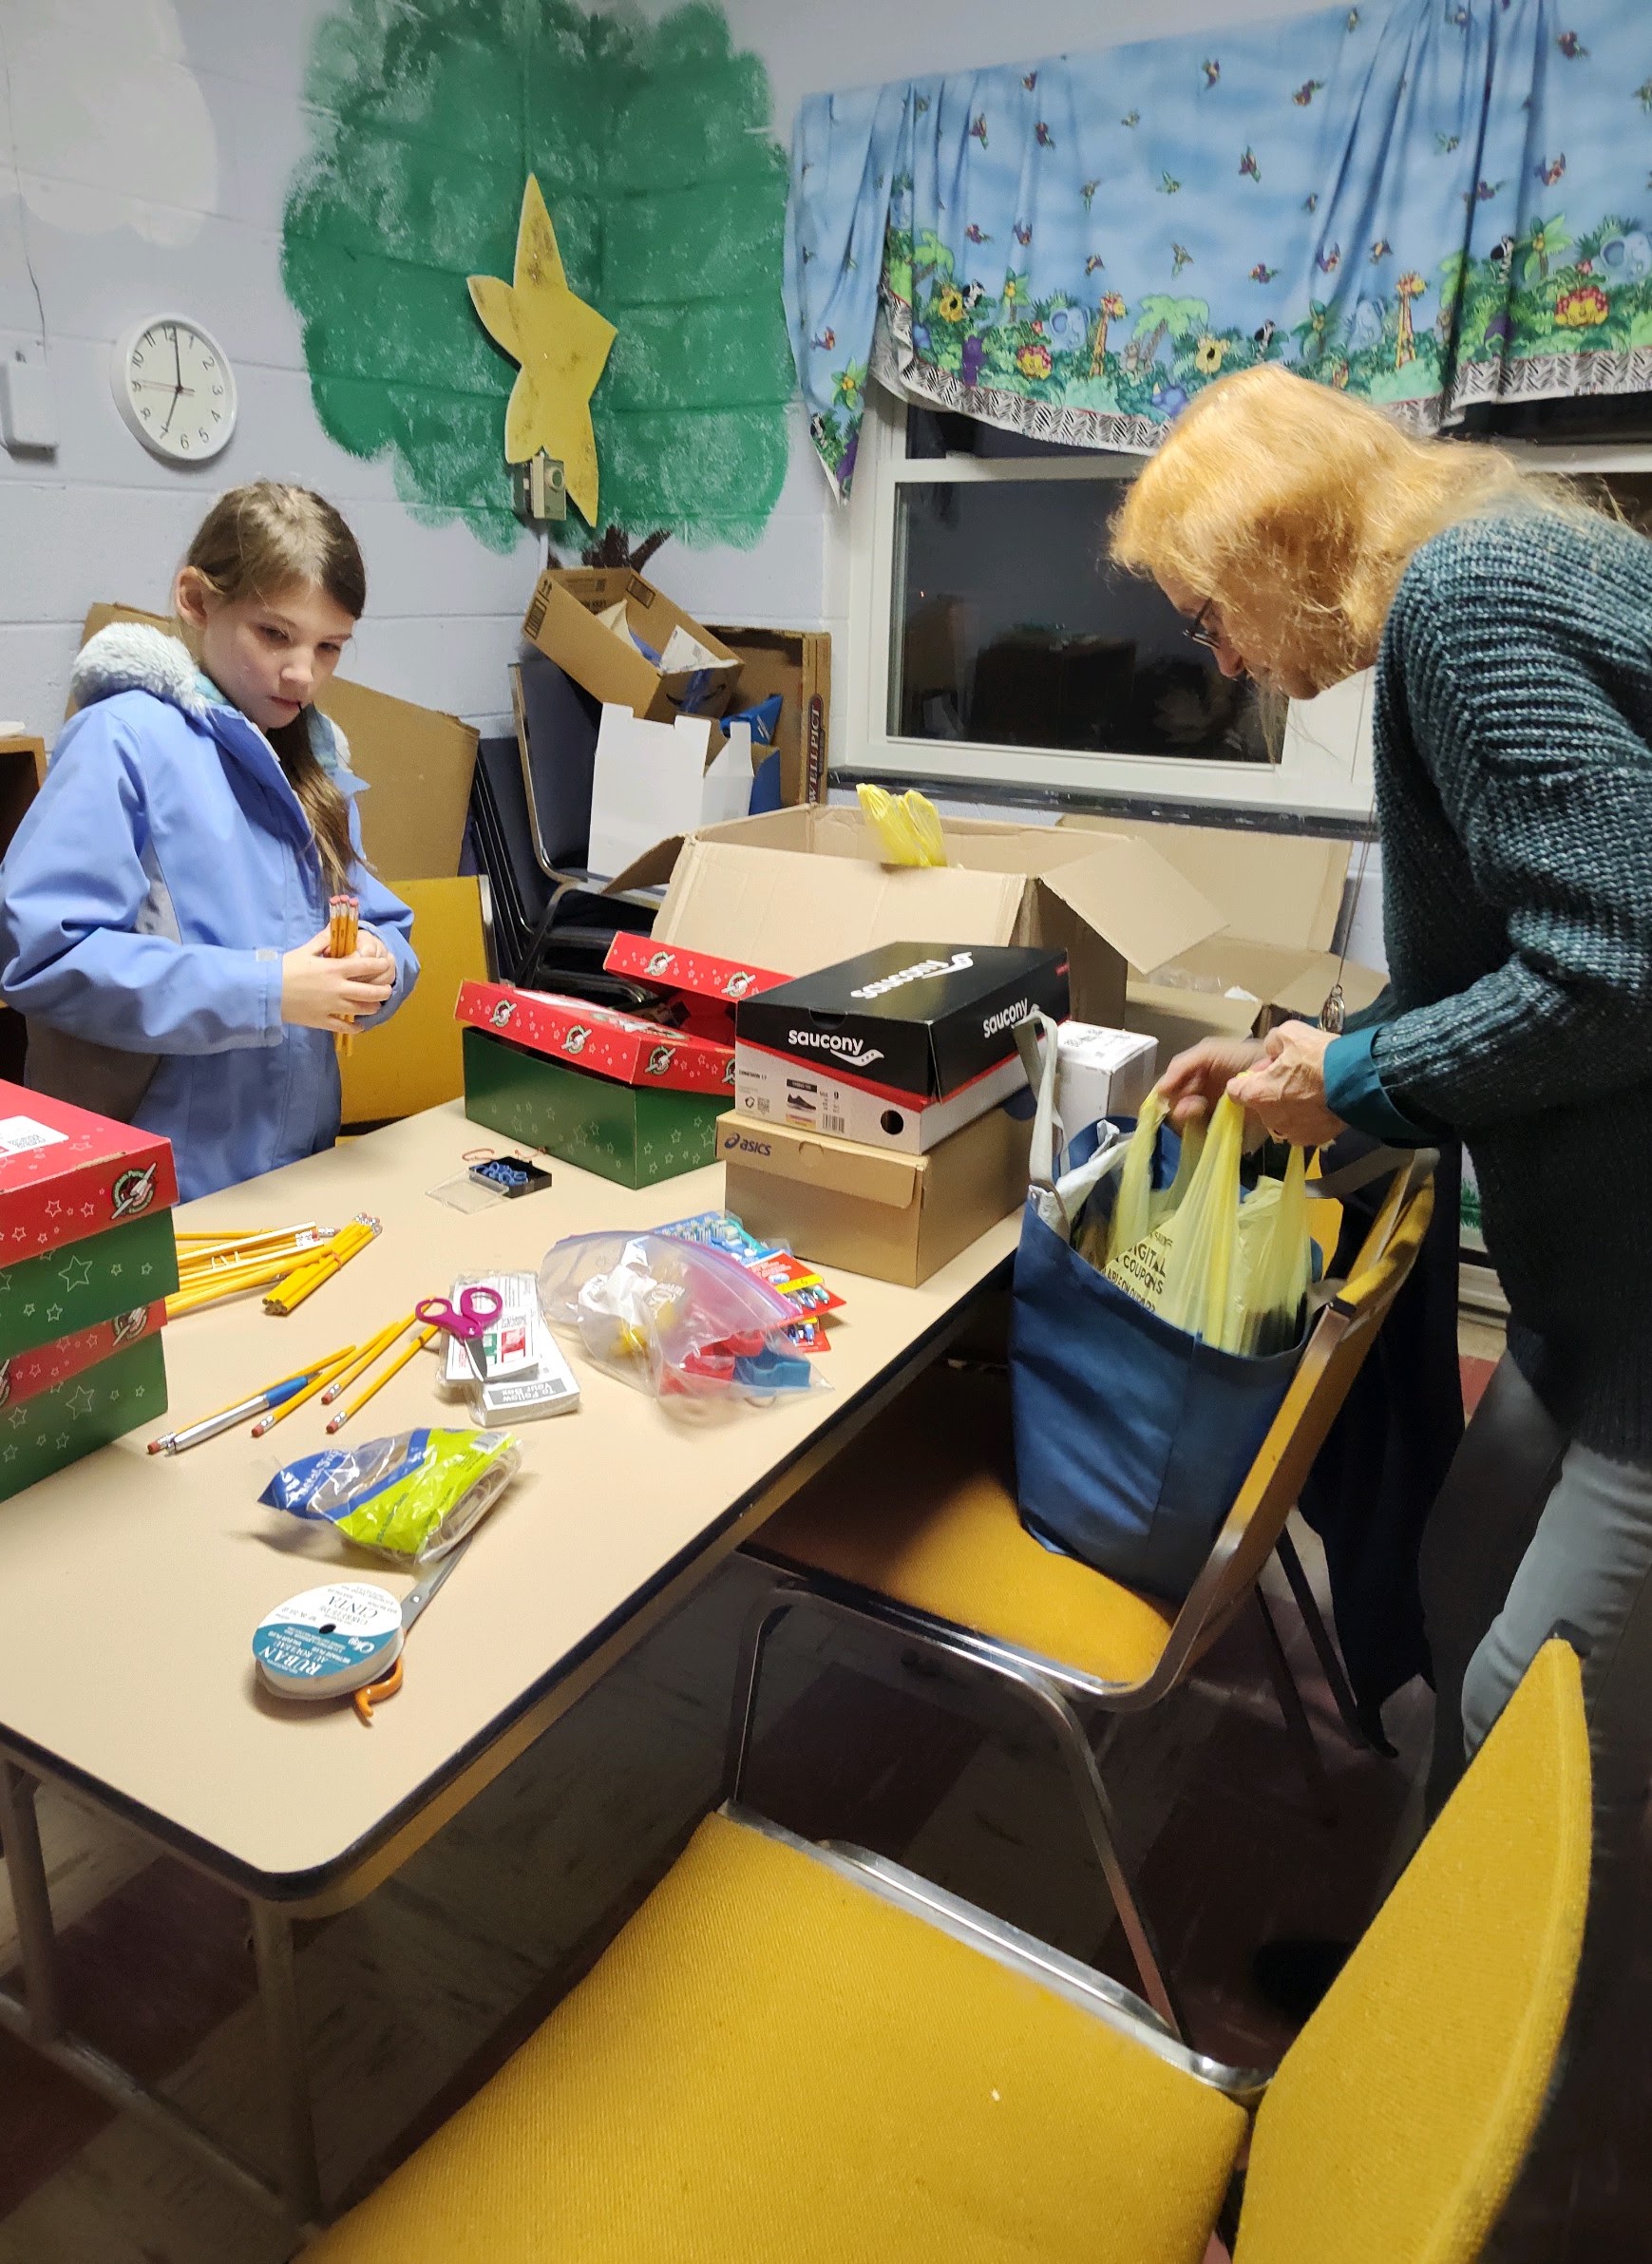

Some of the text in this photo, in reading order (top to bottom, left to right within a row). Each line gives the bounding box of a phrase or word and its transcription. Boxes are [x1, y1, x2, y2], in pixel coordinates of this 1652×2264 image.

[142, 330, 157, 348] 11
[132, 350, 143, 369] 10
[202, 355, 215, 371] 2
[212, 385, 223, 396] 3
[211, 409, 222, 423] 4
[180, 433, 189, 449] 6
[198, 427, 209, 443] 5
[983, 998, 1029, 1038] saucony
[788, 1029, 864, 1056] saucony
[740, 1138, 771, 1156] asics
[1123, 1254, 1165, 1295] COUPONS
[526, 1382, 553, 1392] Your
[503, 1391, 540, 1402] Follow
[327, 1595, 379, 1620] CINTA
[258, 1645, 323, 1675] RUBAN
